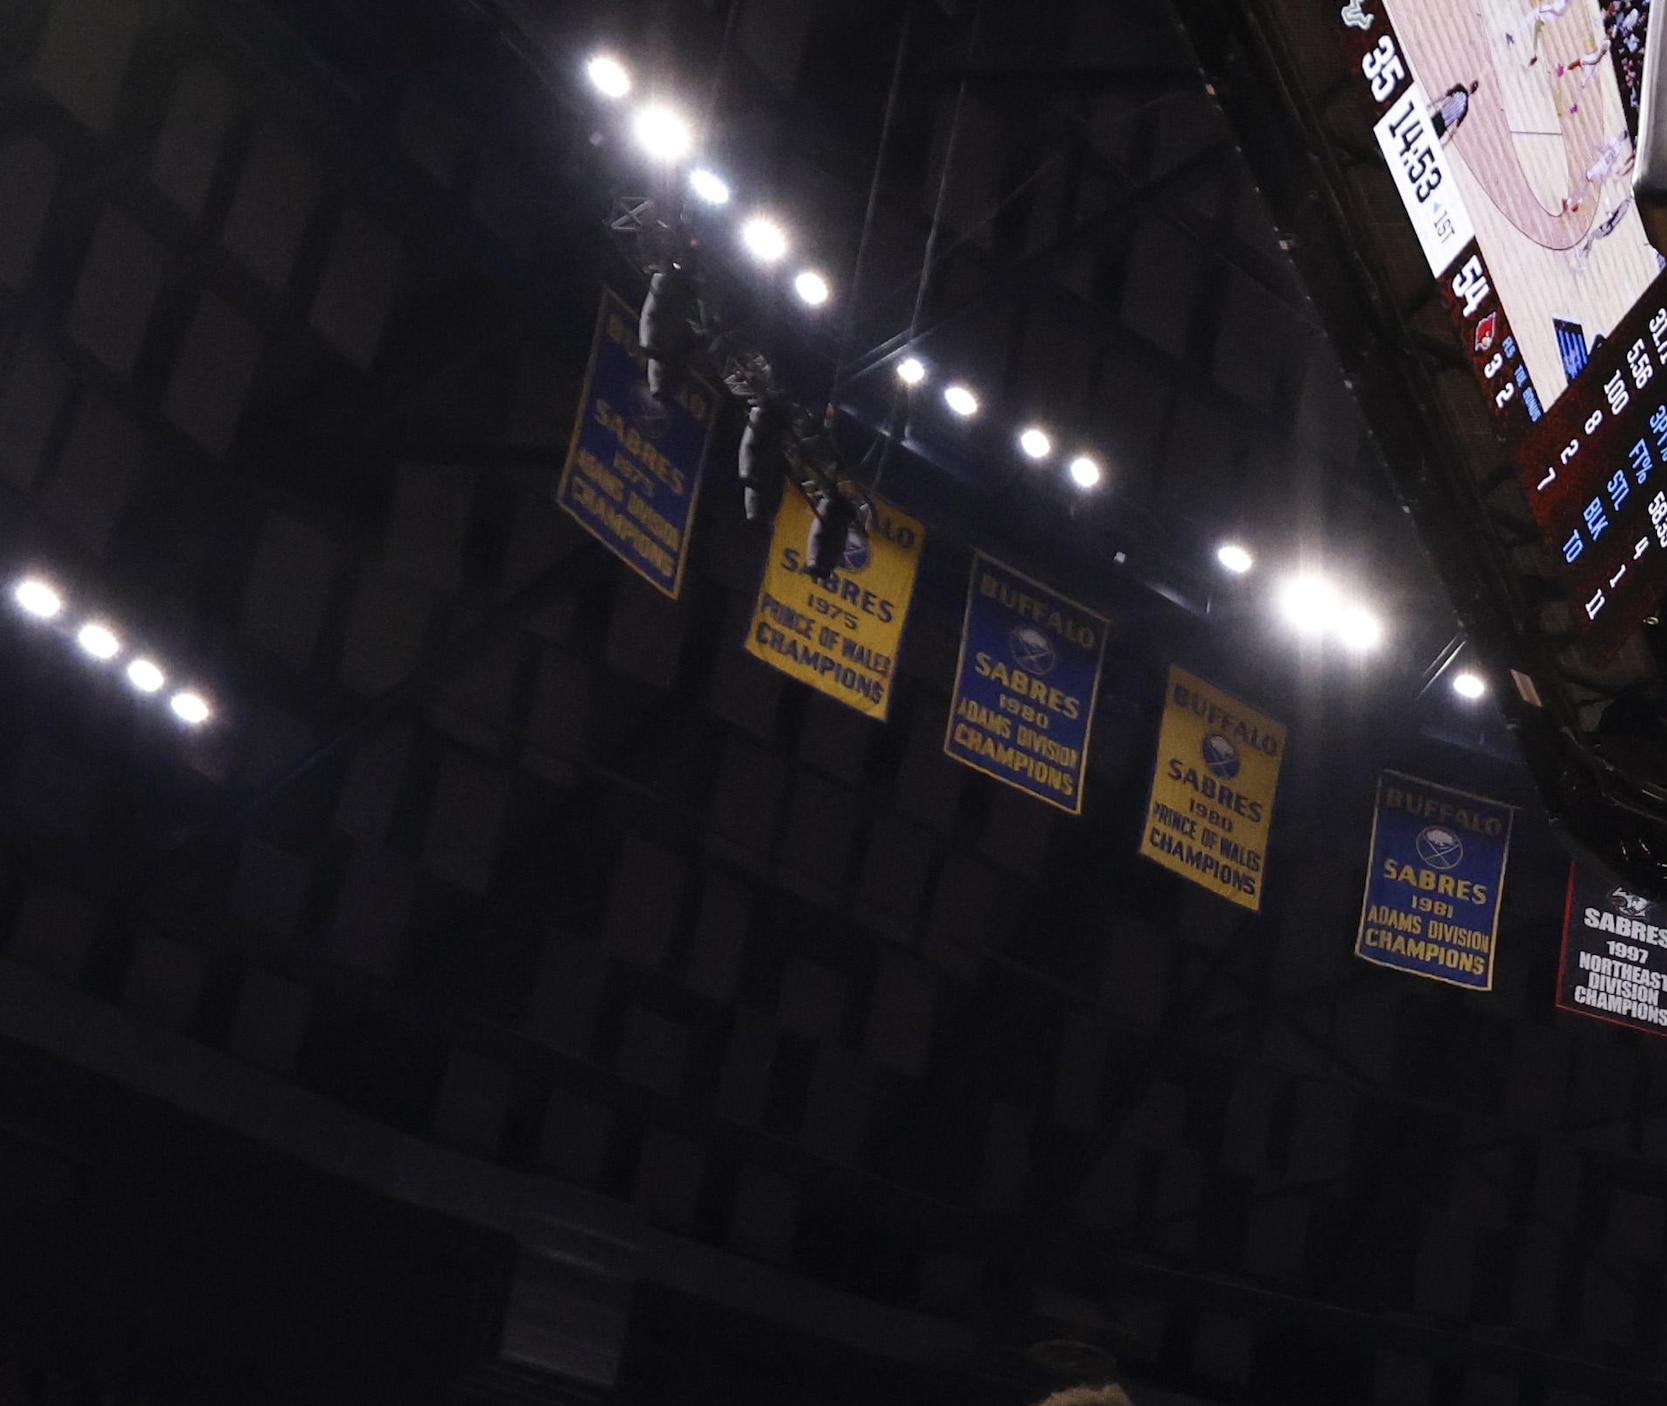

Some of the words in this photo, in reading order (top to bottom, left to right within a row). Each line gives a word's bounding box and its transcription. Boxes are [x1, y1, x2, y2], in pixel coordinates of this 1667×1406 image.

[1362, 34, 1404, 103] 35
[1389, 101, 1441, 203] 14:53
[1433, 211, 1455, 244] 1ST
[1452, 254, 1490, 318] 54
[1484, 353, 1503, 379] 3
[1495, 382, 1514, 408] 2
[1603, 369, 1630, 416] 100
[1584, 409, 1603, 435] 8
[1561, 438, 1579, 465] 2
[1628, 438, 1653, 485] FT%
[1536, 466, 1556, 491] 7
[1607, 469, 1630, 511] STL
[1583, 496, 1608, 541] BLK
[1562, 528, 1584, 564] TO
[1633, 535, 1650, 561] 4
[1609, 563, 1626, 588] 1
[761, 593, 815, 639] PRINCE
[819, 627, 838, 650] OF
[808, 594, 858, 630] 1975
[756, 622, 884, 704] CHAMPIONS
[974, 652, 1079, 721] SABRES
[957, 698, 1011, 740] ADAMS
[1018, 724, 1079, 769] DIVISION
[999, 694, 1048, 729] 1980
[1173, 684, 1278, 757] BUFFALO
[954, 723, 1073, 796] CHAMPIONS
[1167, 757, 1262, 823] SABRES
[1153, 801, 1197, 840] PRINCE
[1201, 828, 1218, 848] OF
[1219, 832, 1261, 873] WALES
[1189, 798, 1233, 833] 1980
[1150, 827, 1256, 896] CHAMPIONS
[1383, 858, 1487, 905] SABRES
[1367, 904, 1422, 935] ADAMS
[1428, 921, 1490, 954] DIVISION
[1410, 894, 1454, 919] 1981
[1364, 927, 1486, 976] CHAMPIONS
[1606, 940, 1650, 965] 1997
[1588, 973, 1660, 1006] DIVISION
